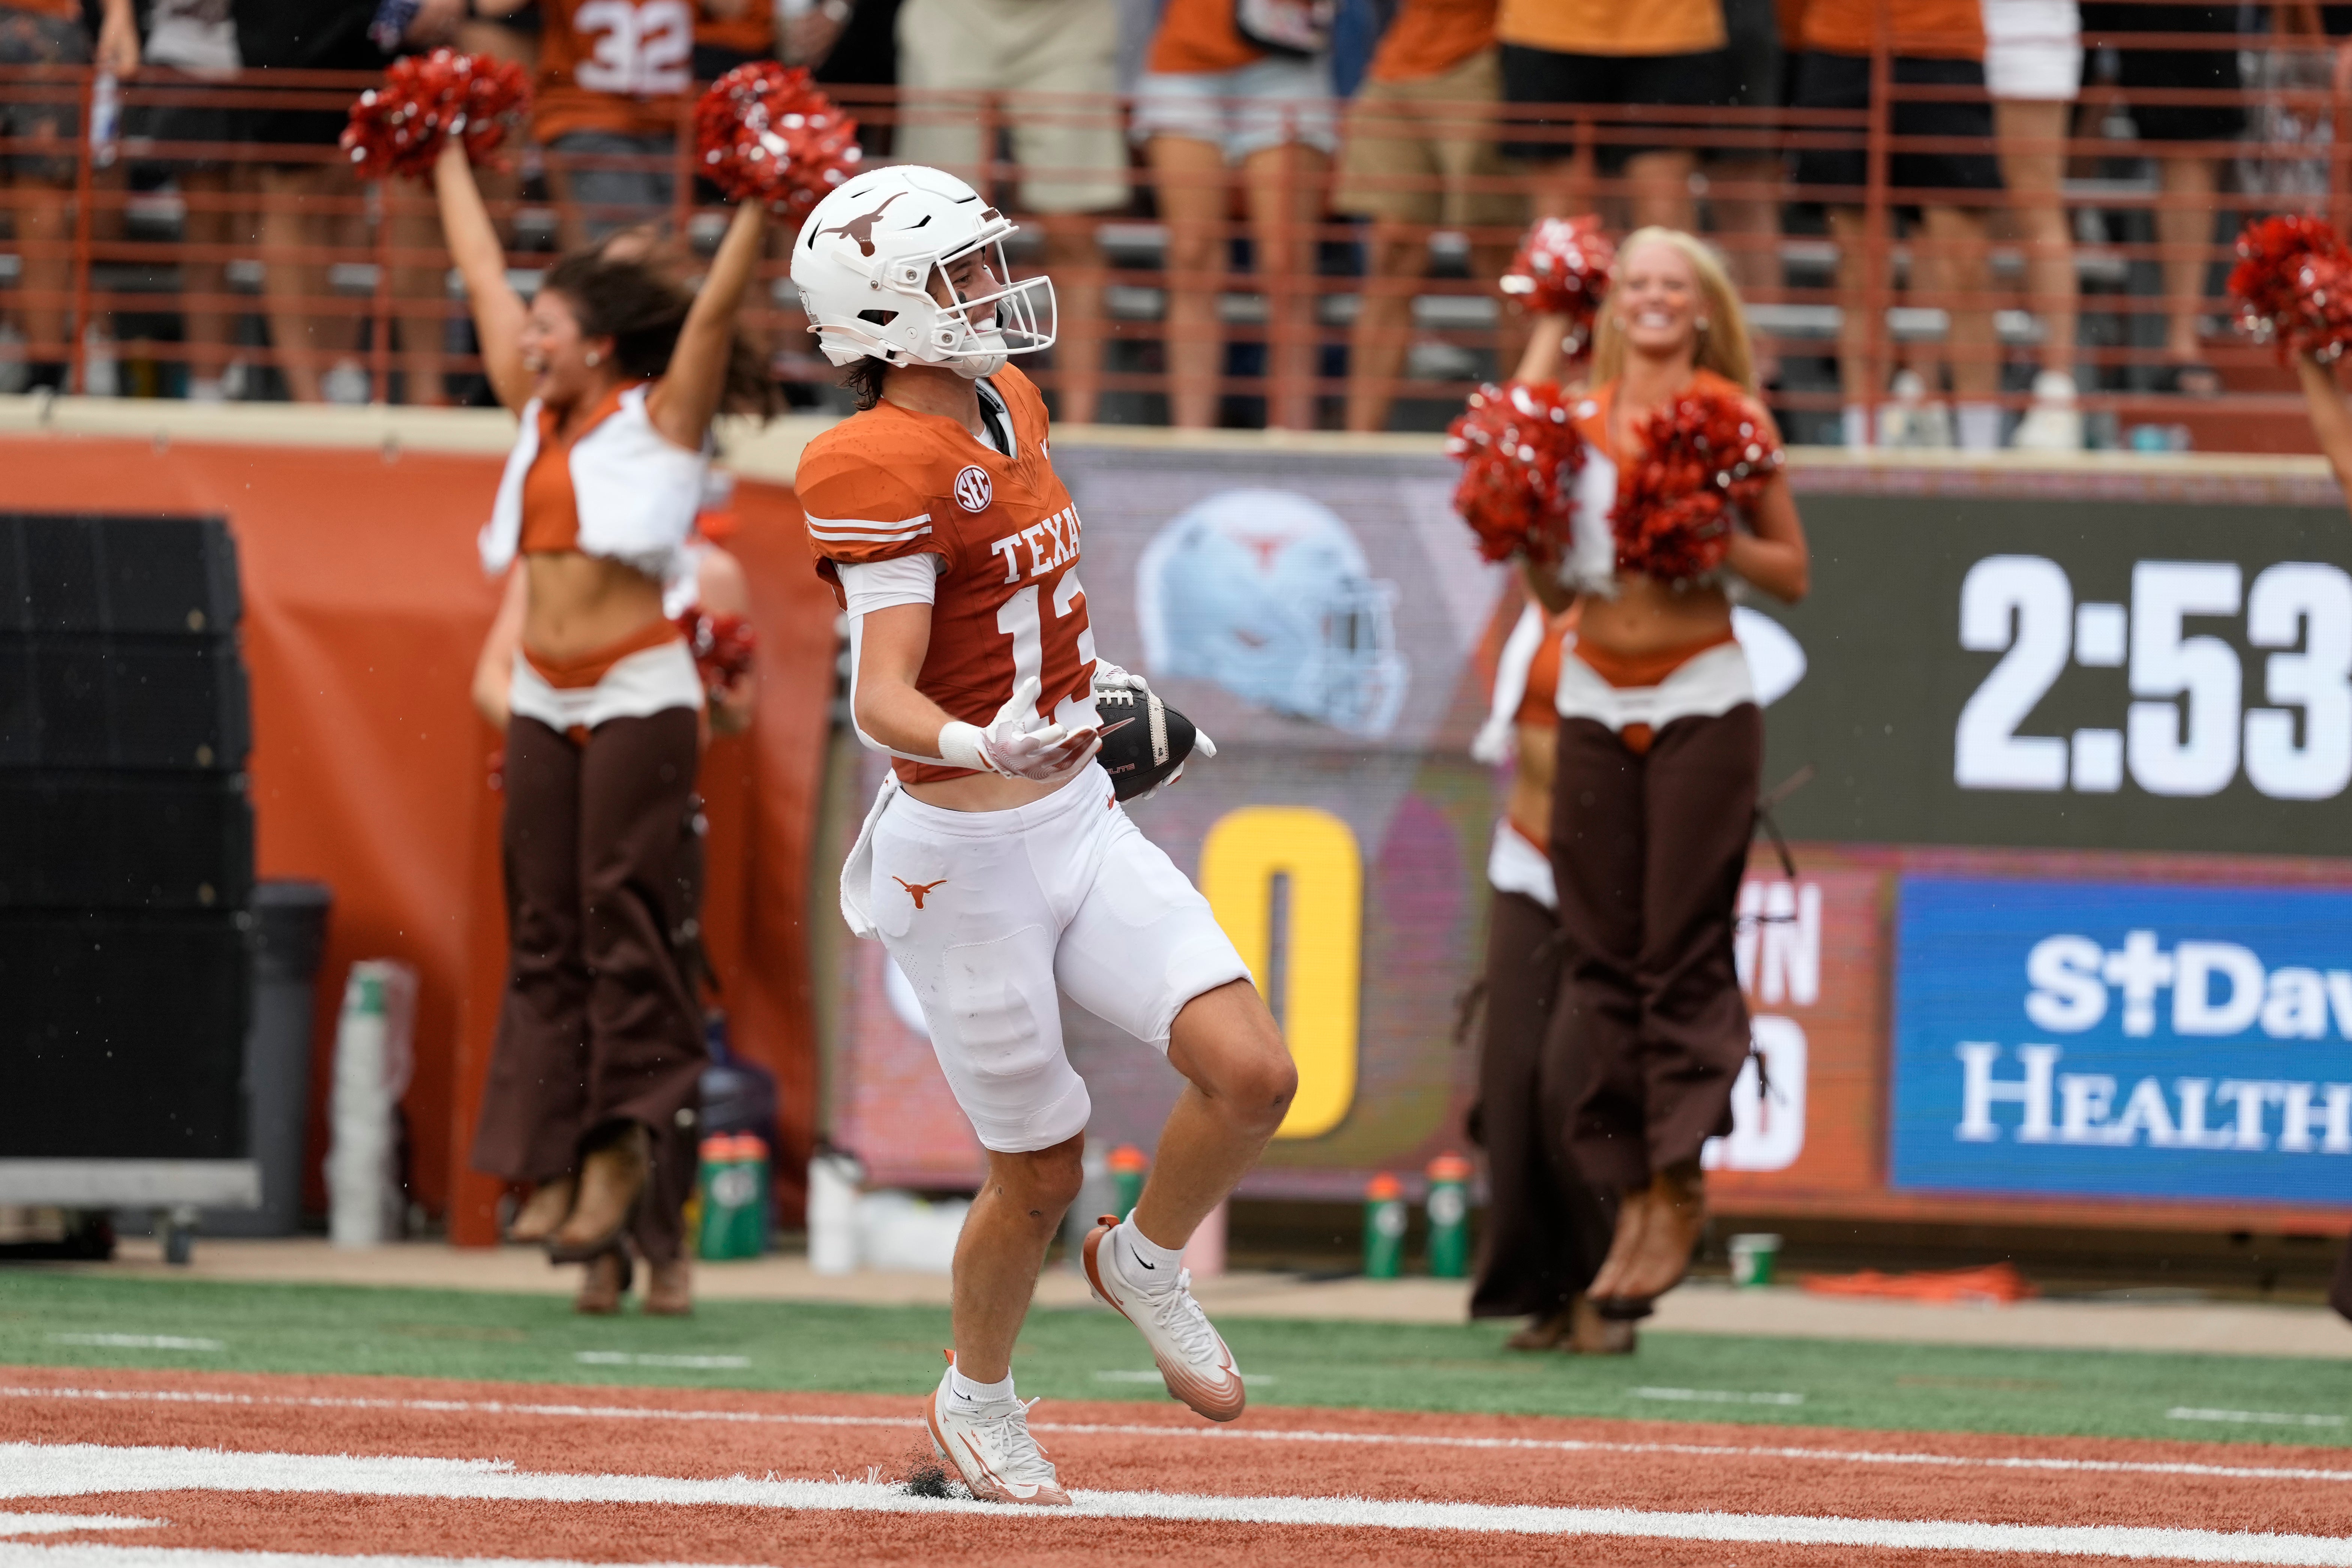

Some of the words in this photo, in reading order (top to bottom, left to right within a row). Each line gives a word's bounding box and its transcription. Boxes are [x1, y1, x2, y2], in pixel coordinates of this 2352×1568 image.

[572, 0, 693, 94] 32
[957, 468, 990, 509] SEC
[997, 564, 1104, 734] 13
[1953, 553, 2352, 801] 2:53
[1200, 805, 1363, 1140] 0
